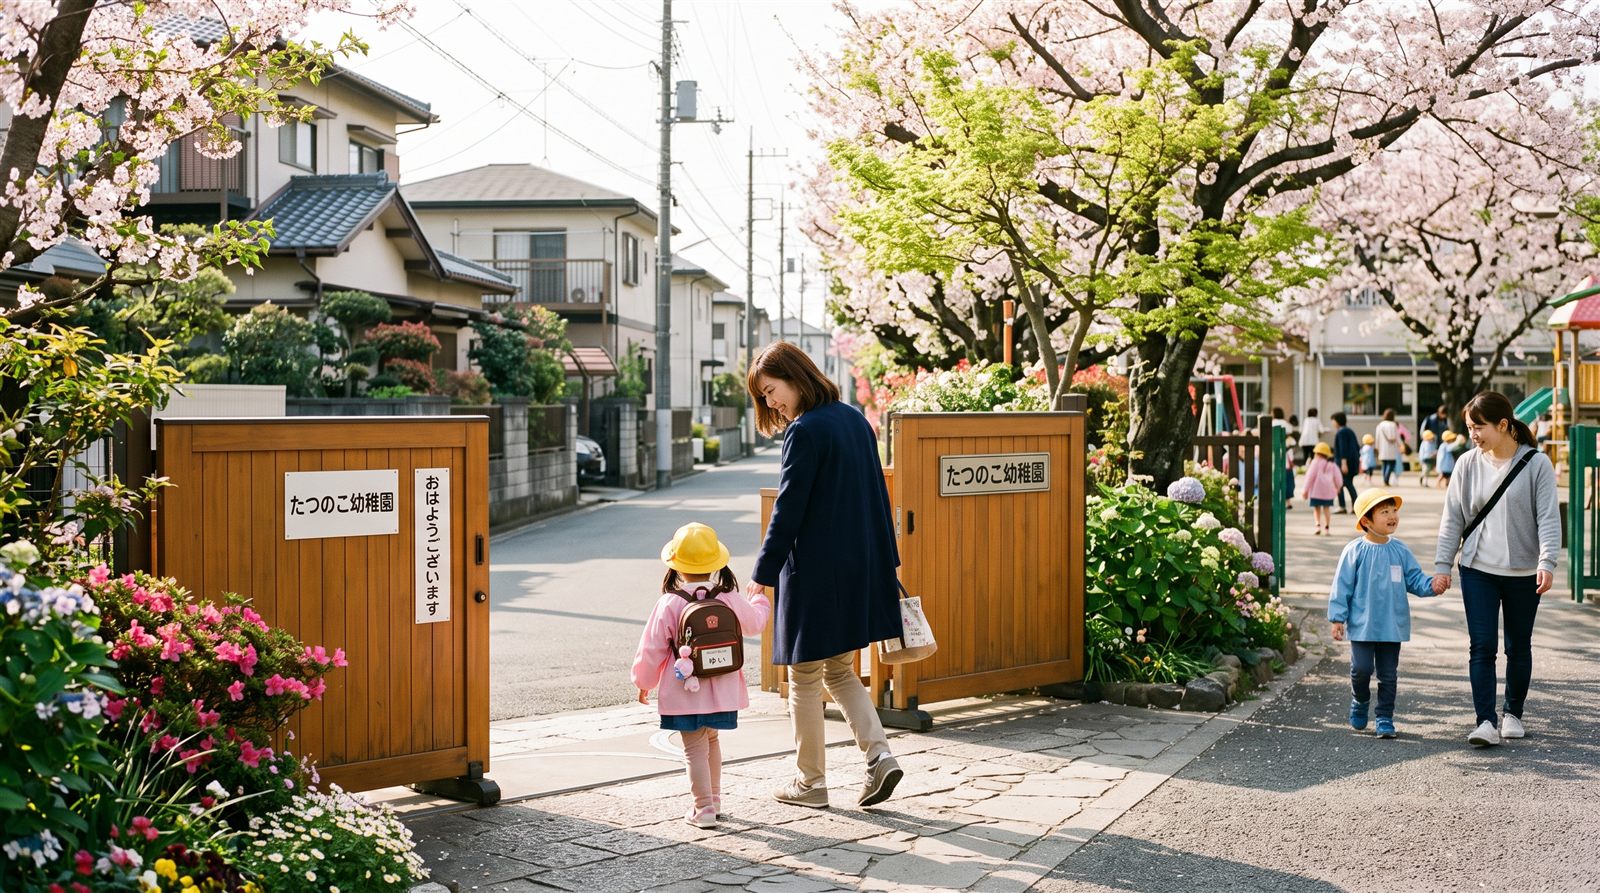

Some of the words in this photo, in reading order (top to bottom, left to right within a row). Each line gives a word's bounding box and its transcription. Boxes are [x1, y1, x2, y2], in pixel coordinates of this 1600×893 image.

[946, 462, 1045, 486] たつのこ幼稚園
[290, 492, 394, 515] たつのこ幼稚園
[425, 475, 440, 616] おはようございます
